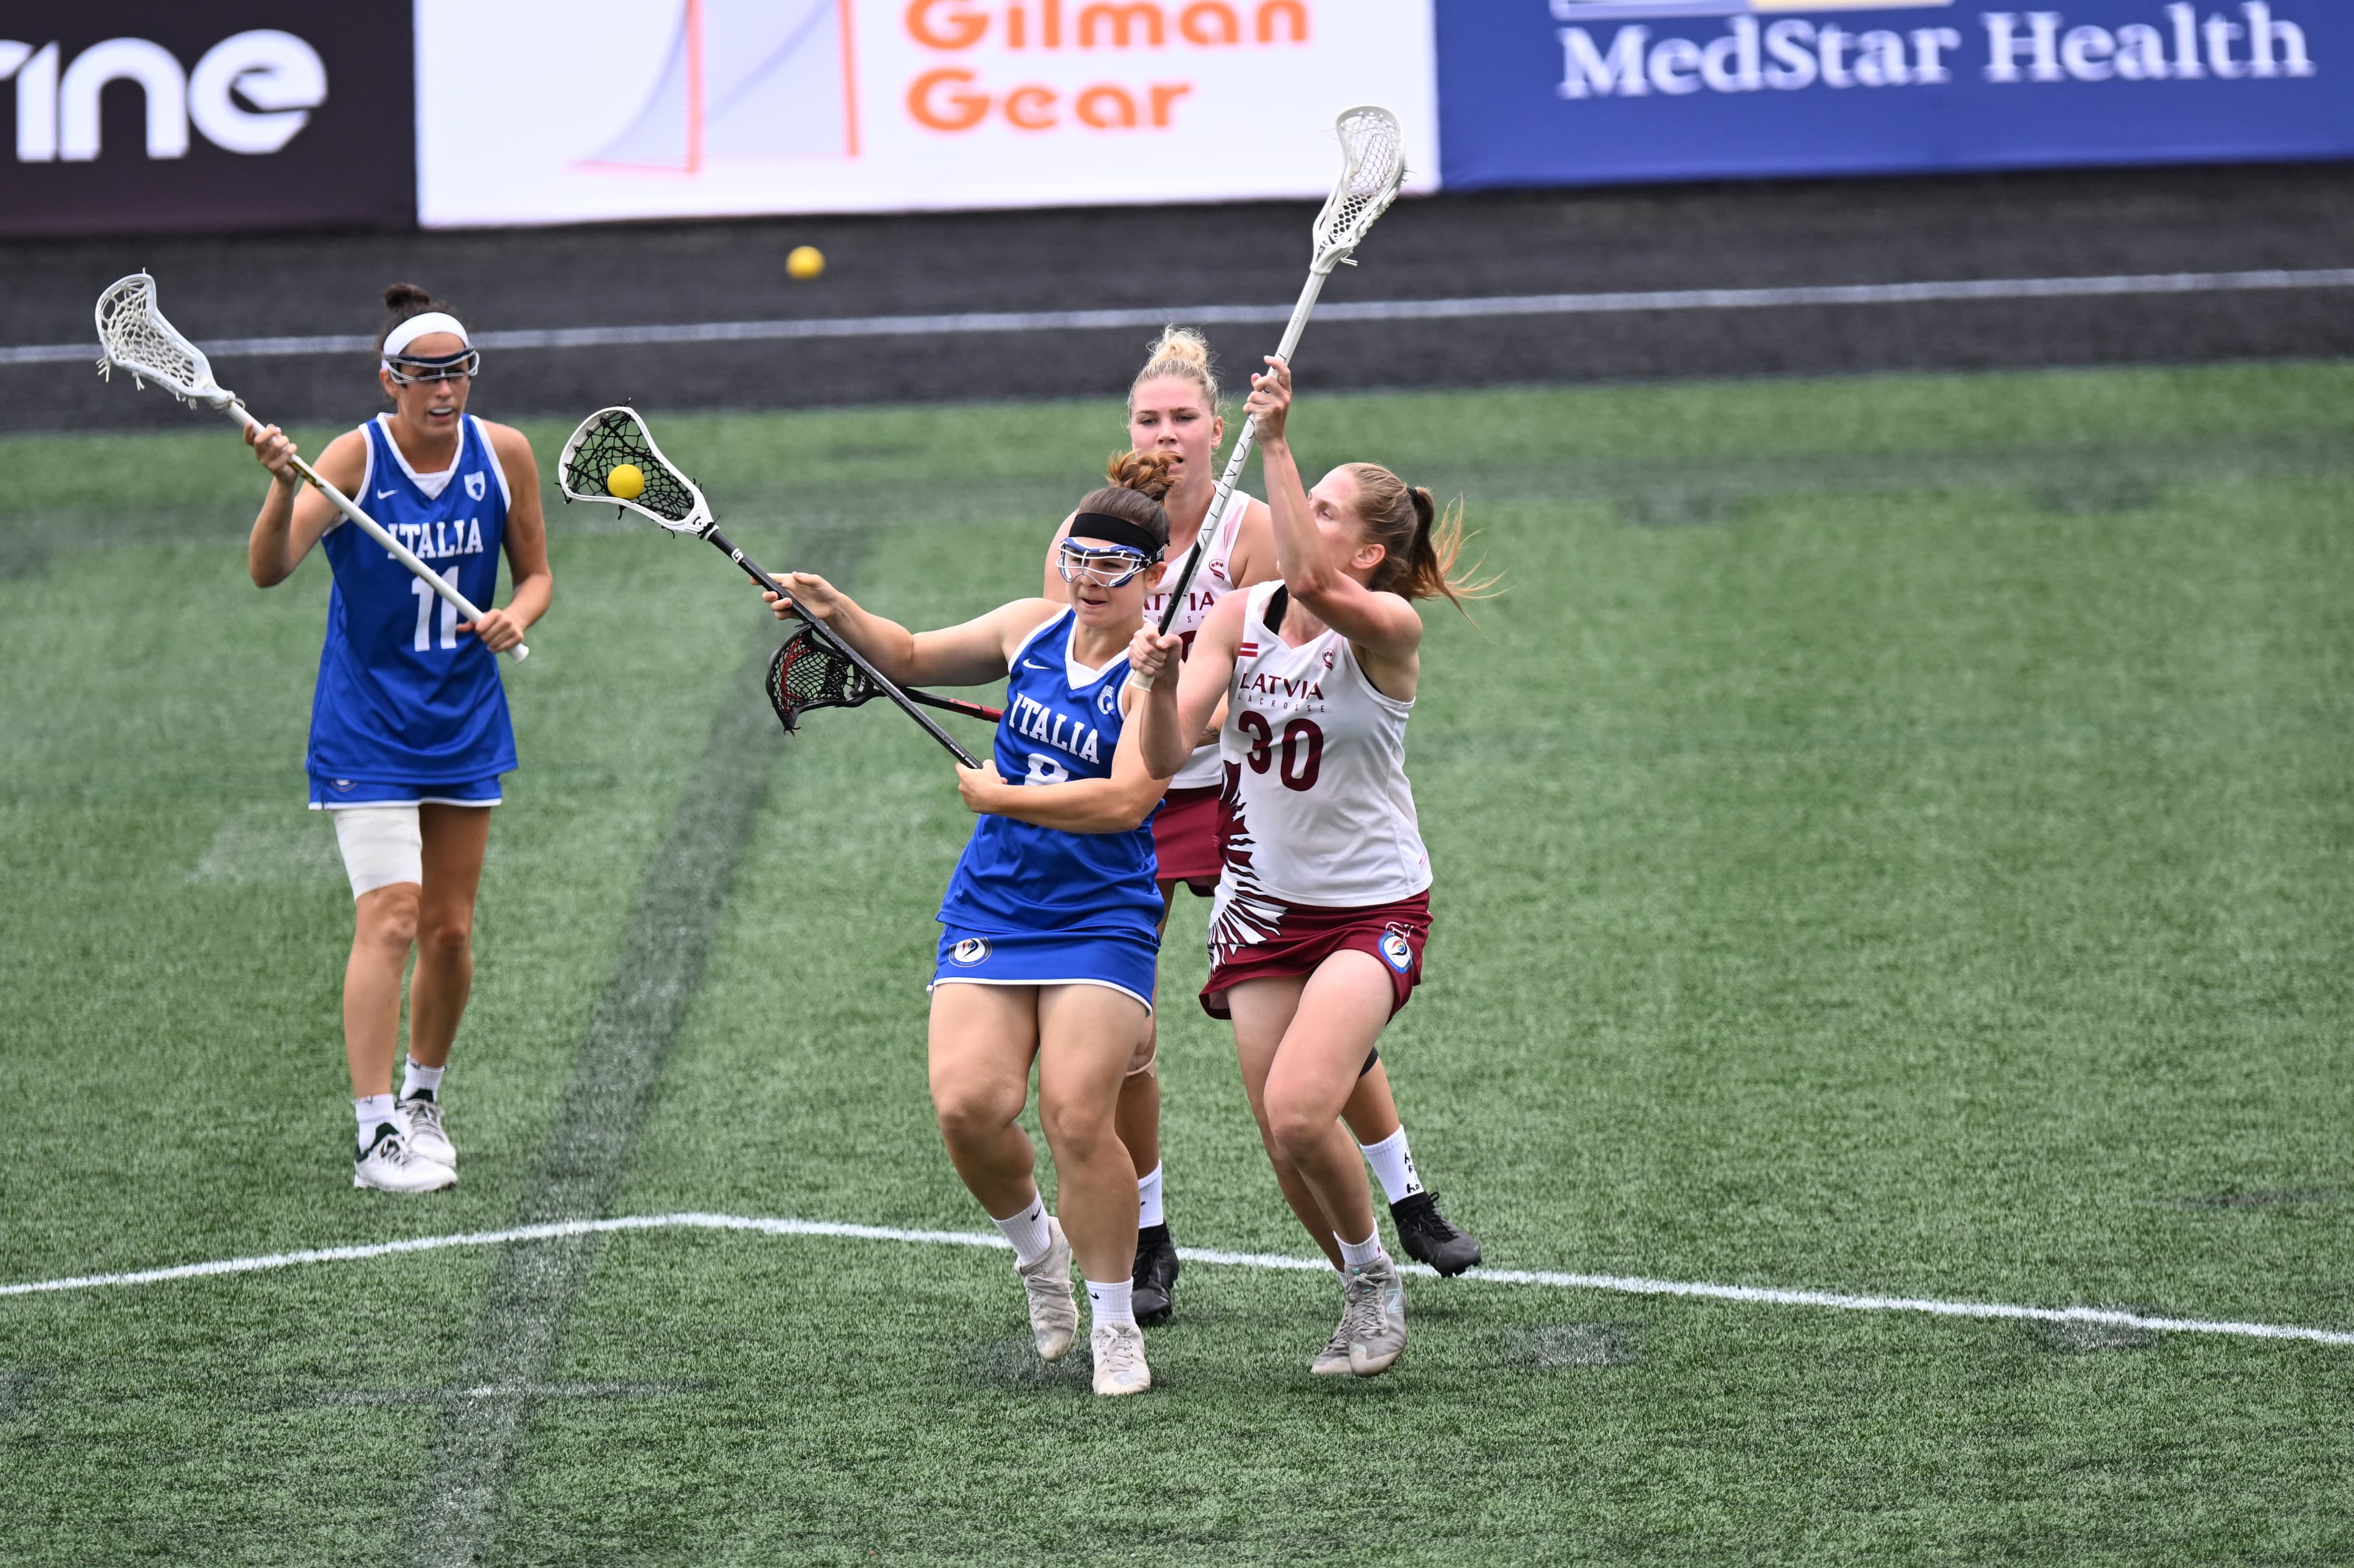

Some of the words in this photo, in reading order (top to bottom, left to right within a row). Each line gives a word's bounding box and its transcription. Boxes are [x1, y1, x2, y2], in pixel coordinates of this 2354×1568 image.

[905, 0, 1309, 51] Gilman
[1555, 15, 1961, 99] MedStar
[1981, 0, 2317, 83] Health
[906, 67, 1192, 132] Gear
[387, 517, 484, 560] ITALIA
[411, 565, 459, 652] 11
[1238, 693, 1325, 713] LACROSSE
[1239, 672, 1324, 701] LATVIA
[1008, 692, 1099, 764] ITALIA
[1238, 710, 1324, 792] 30
